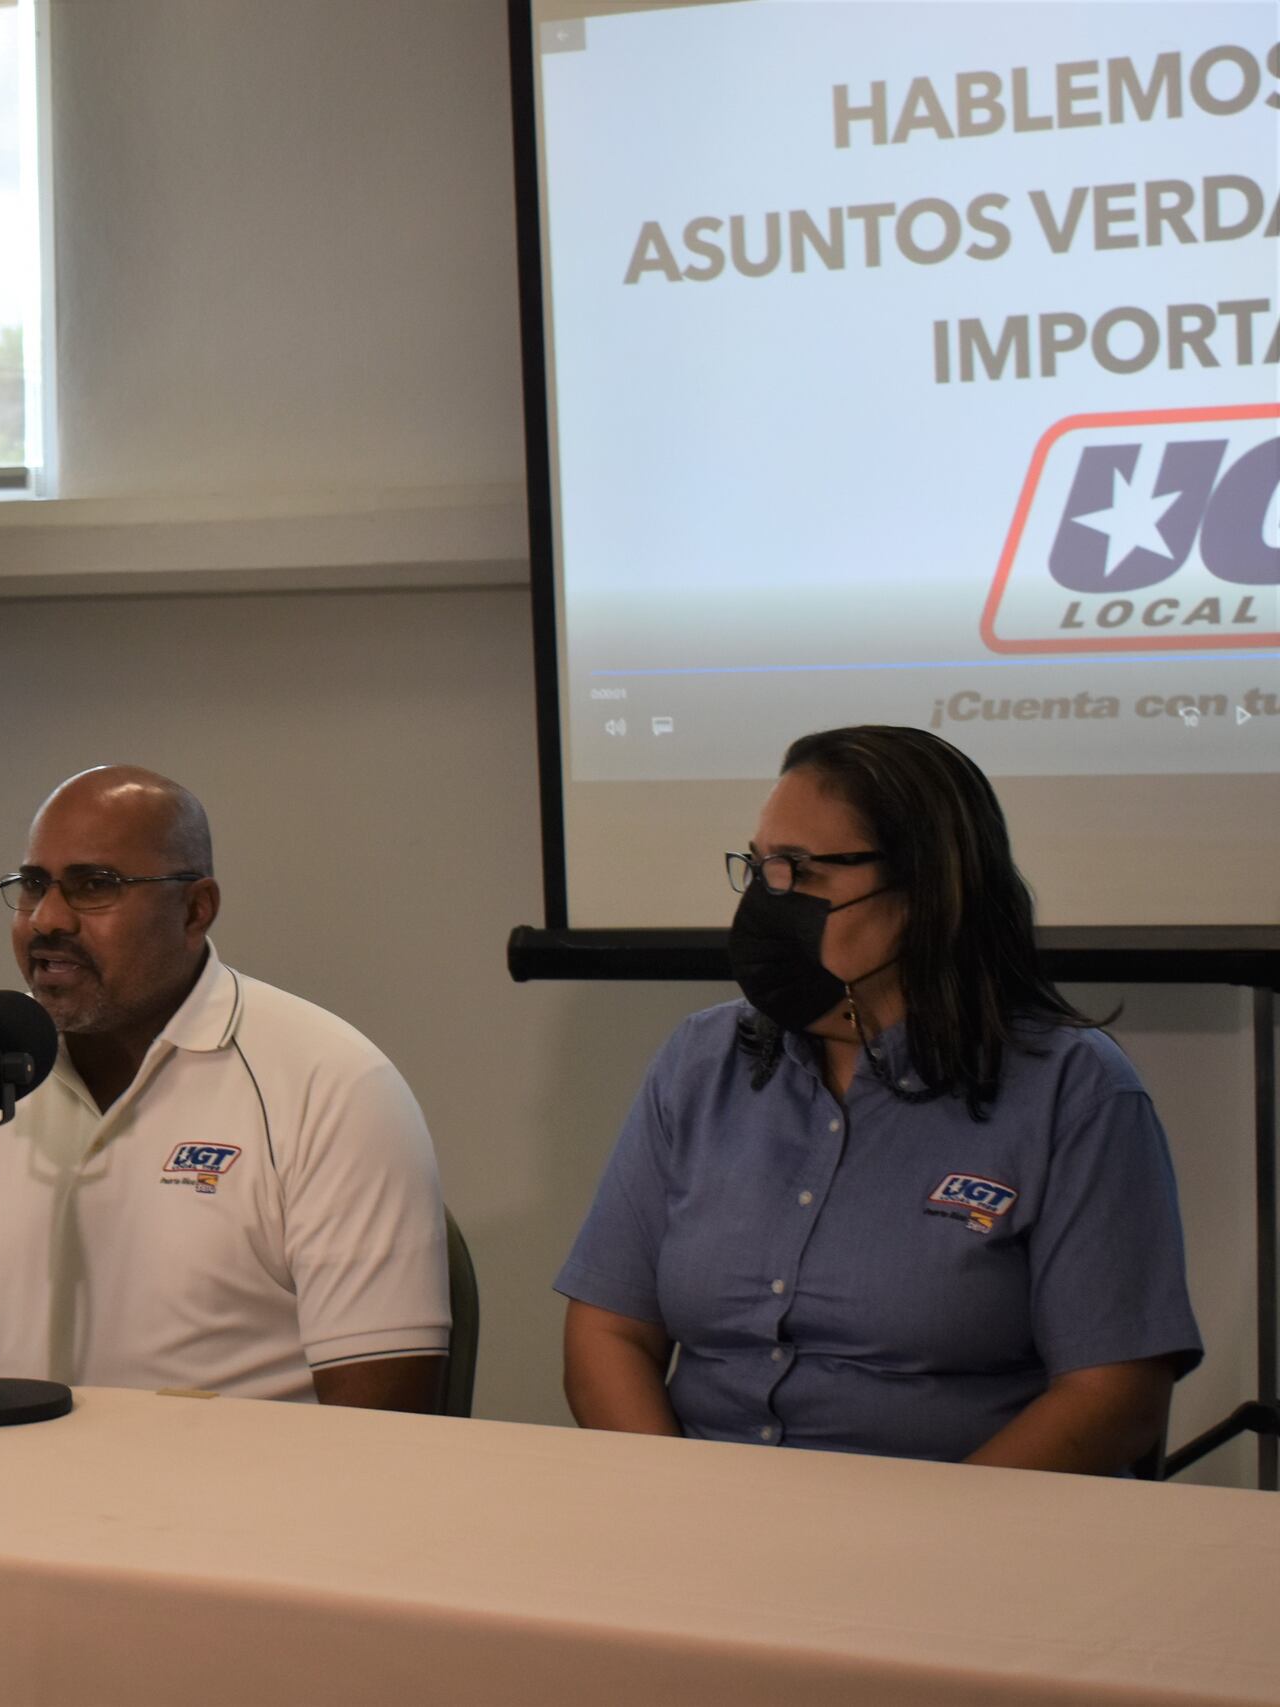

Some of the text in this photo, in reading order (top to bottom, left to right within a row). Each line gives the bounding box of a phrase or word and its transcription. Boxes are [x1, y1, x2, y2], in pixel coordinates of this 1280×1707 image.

[624, 174, 1280, 285] ASUNTOS VERD
[933, 298, 1280, 384] IMPORT
[1059, 596, 1260, 630] LOCAL
[929, 690, 1120, 729] ¡Cuenta
[1135, 692, 1228, 718] con
[173, 1146, 236, 1166] UGT
[941, 1177, 1016, 1206] UGT
